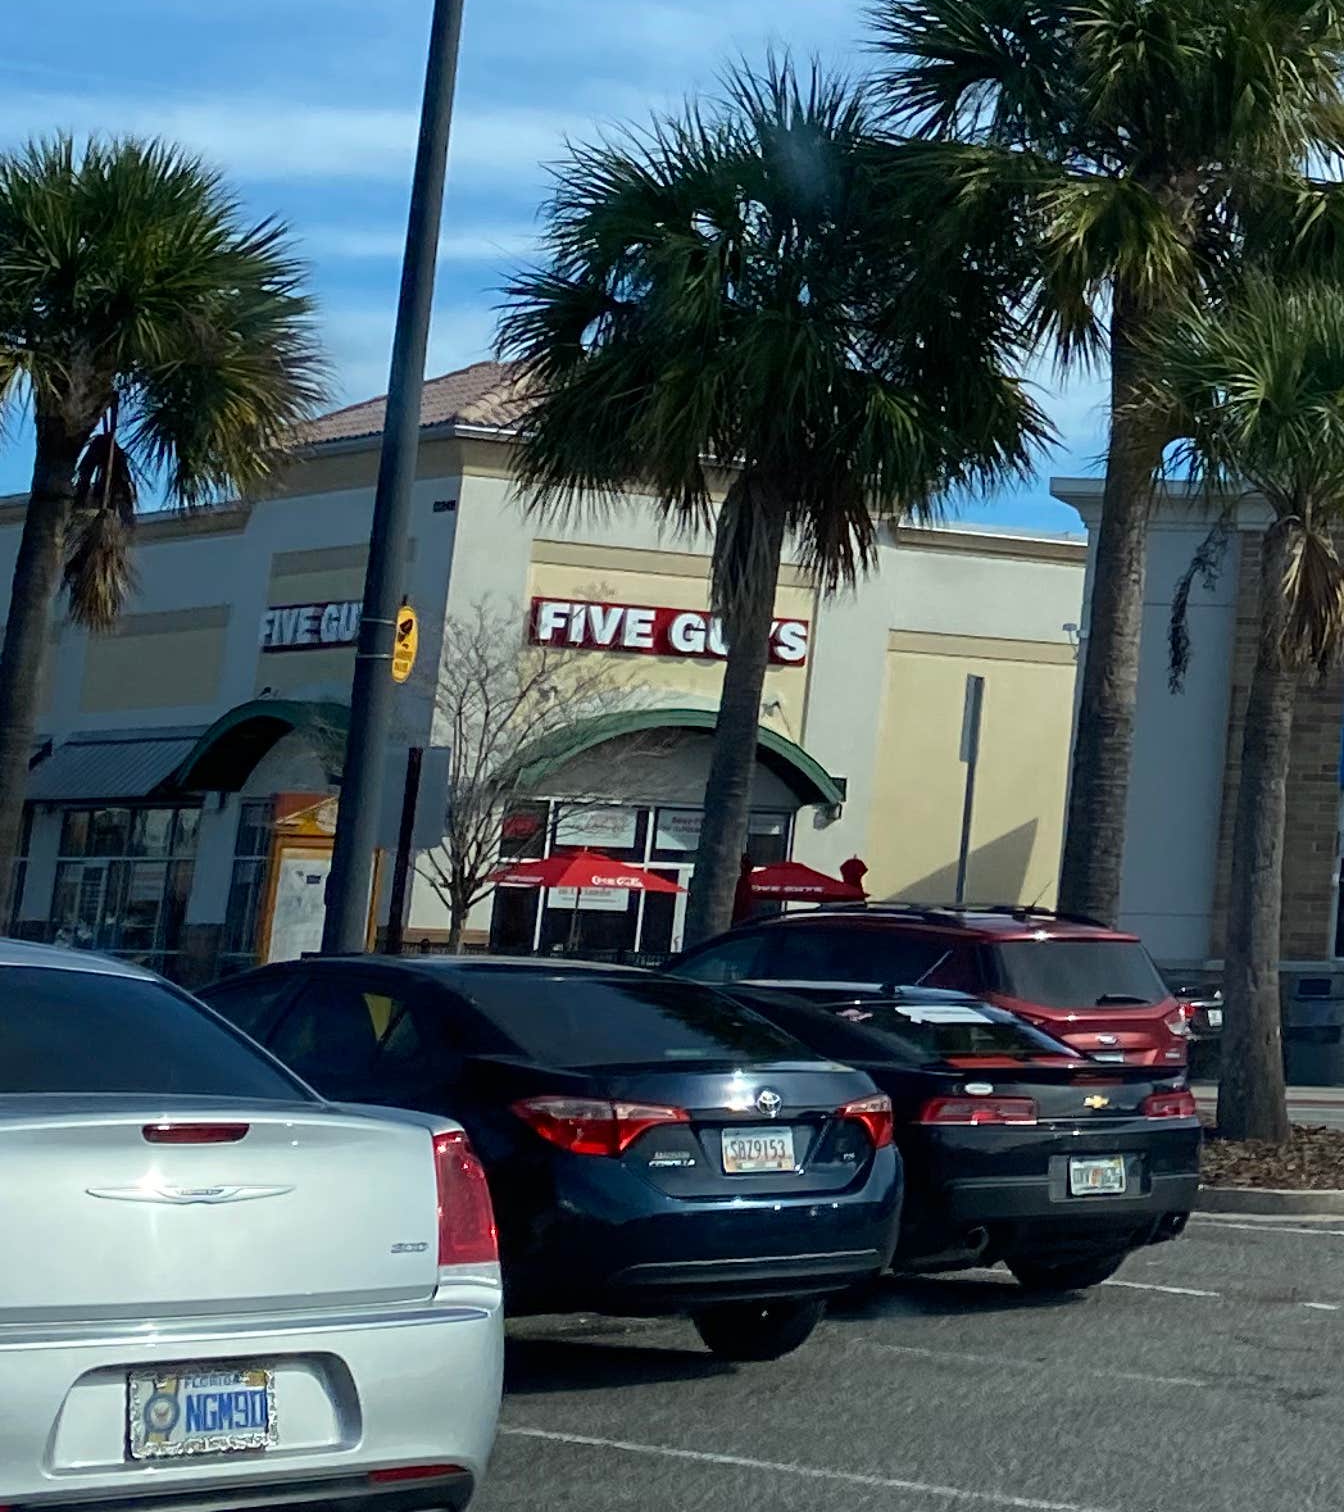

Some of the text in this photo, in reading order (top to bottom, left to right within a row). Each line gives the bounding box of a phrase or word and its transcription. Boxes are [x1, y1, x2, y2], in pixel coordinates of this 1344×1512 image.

[258, 602, 363, 647] FIVE GU
[538, 601, 807, 661] FIVE GUS
